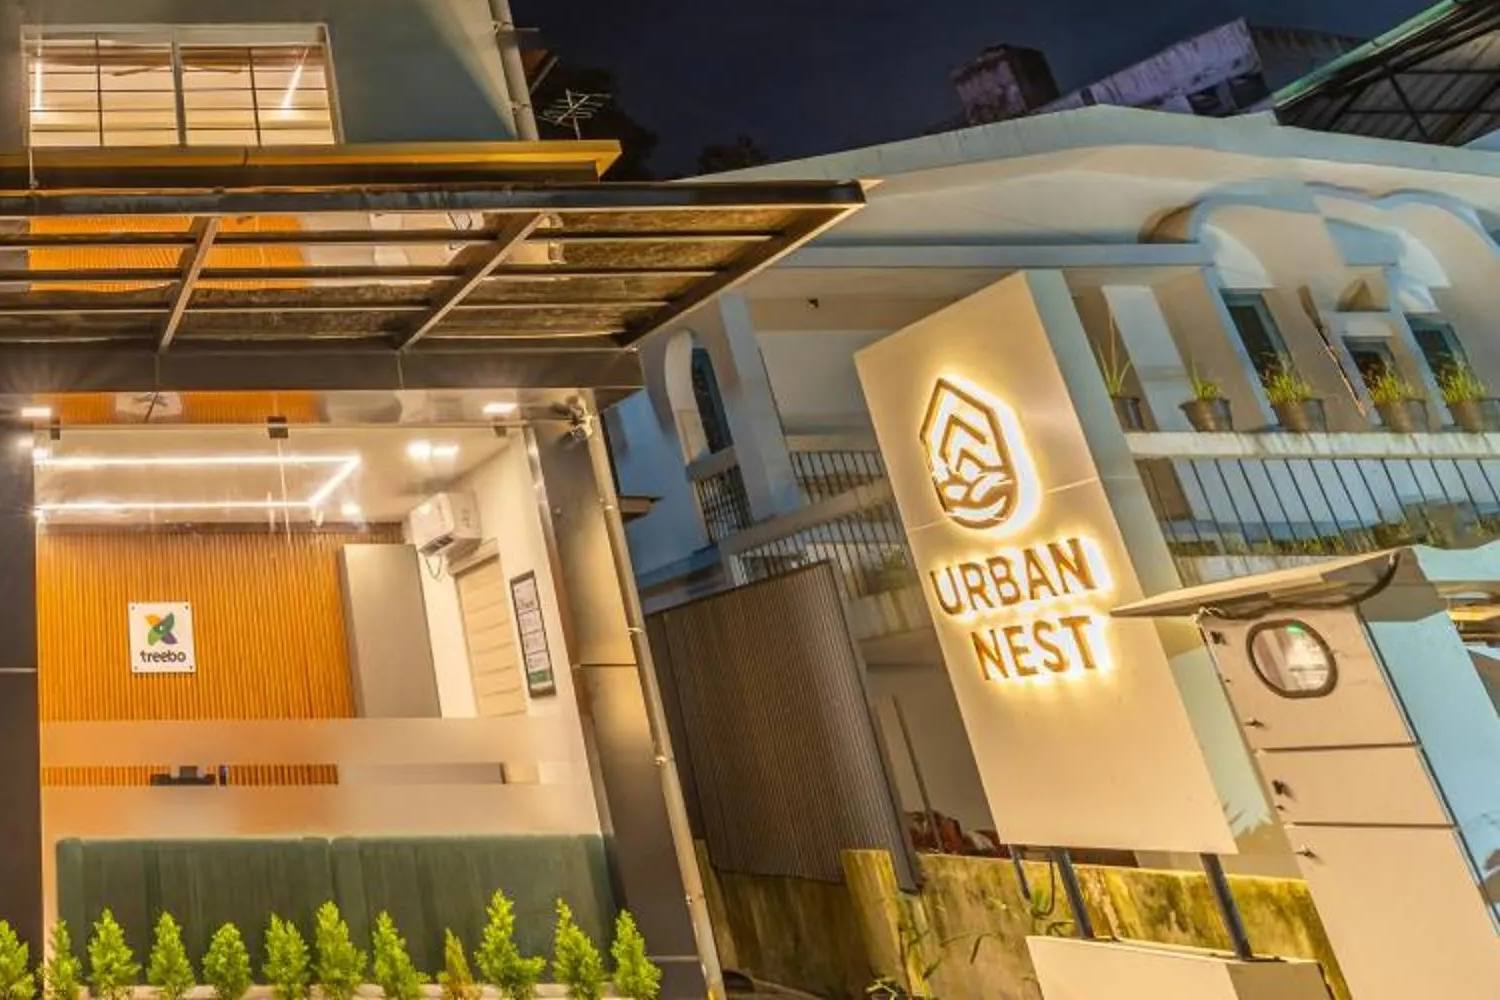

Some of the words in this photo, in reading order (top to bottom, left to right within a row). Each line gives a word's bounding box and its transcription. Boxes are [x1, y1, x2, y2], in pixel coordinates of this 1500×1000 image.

[930, 538, 1097, 615] URBAN
[140, 649, 187, 663] treebo
[971, 615, 1097, 681] NEST
